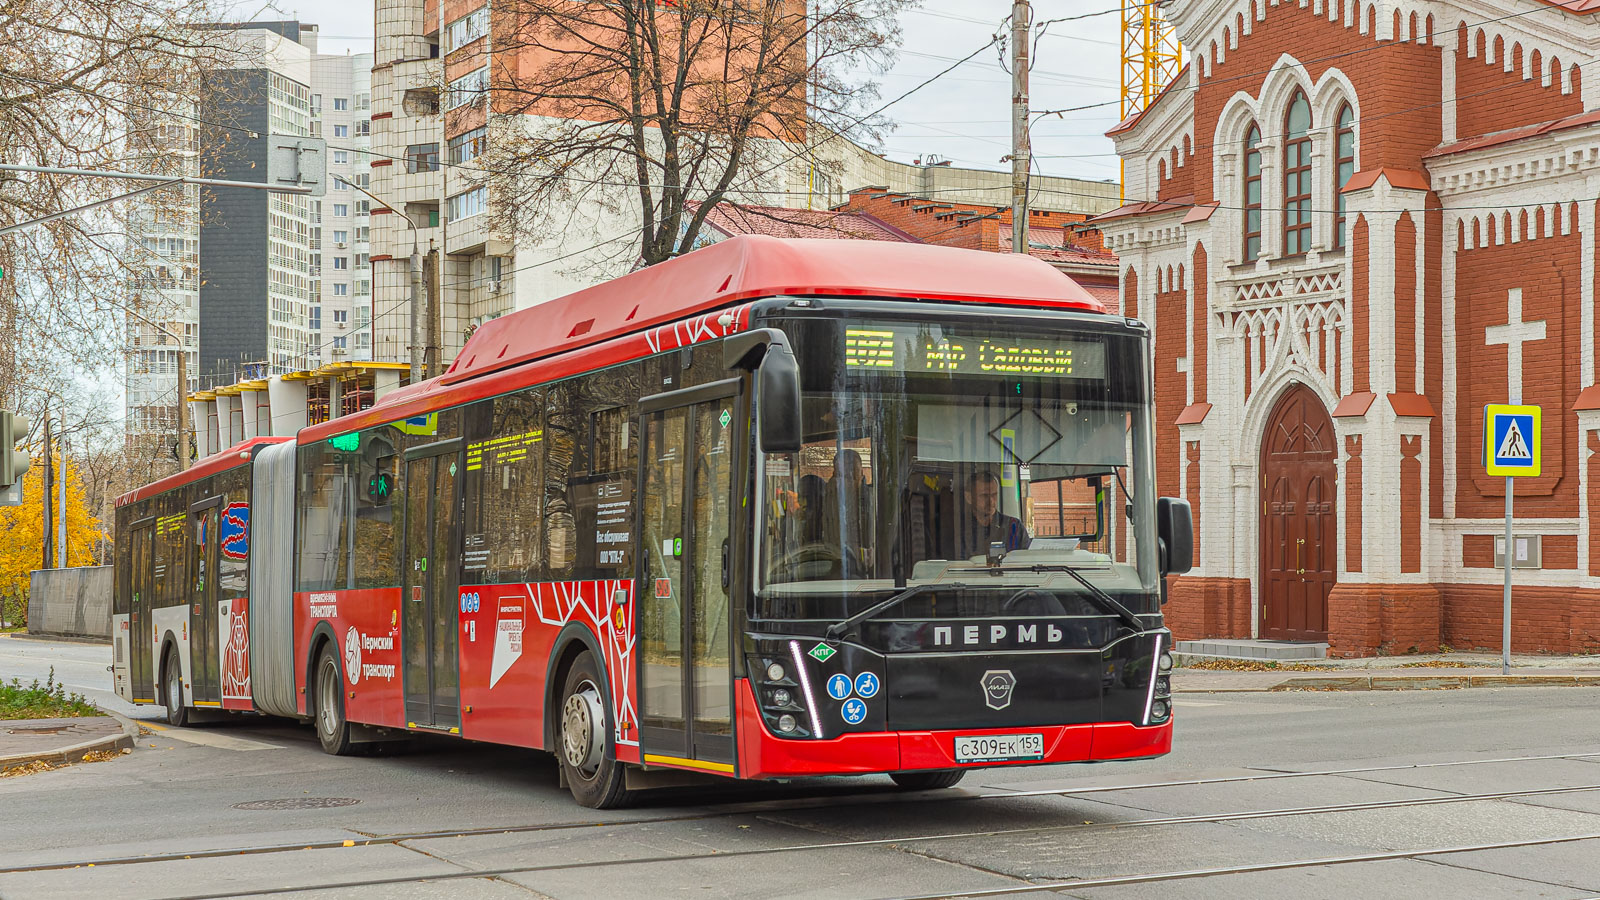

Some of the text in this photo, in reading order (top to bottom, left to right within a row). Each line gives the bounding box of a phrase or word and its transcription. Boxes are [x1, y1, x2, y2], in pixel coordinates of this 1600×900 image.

[361, 631, 394, 655] Пермский
[934, 624, 1063, 646] ПЕРМЬ
[813, 648, 830, 657] КПГ
[362, 663, 396, 683] транспорт
[1019, 736, 1039, 751] 159
